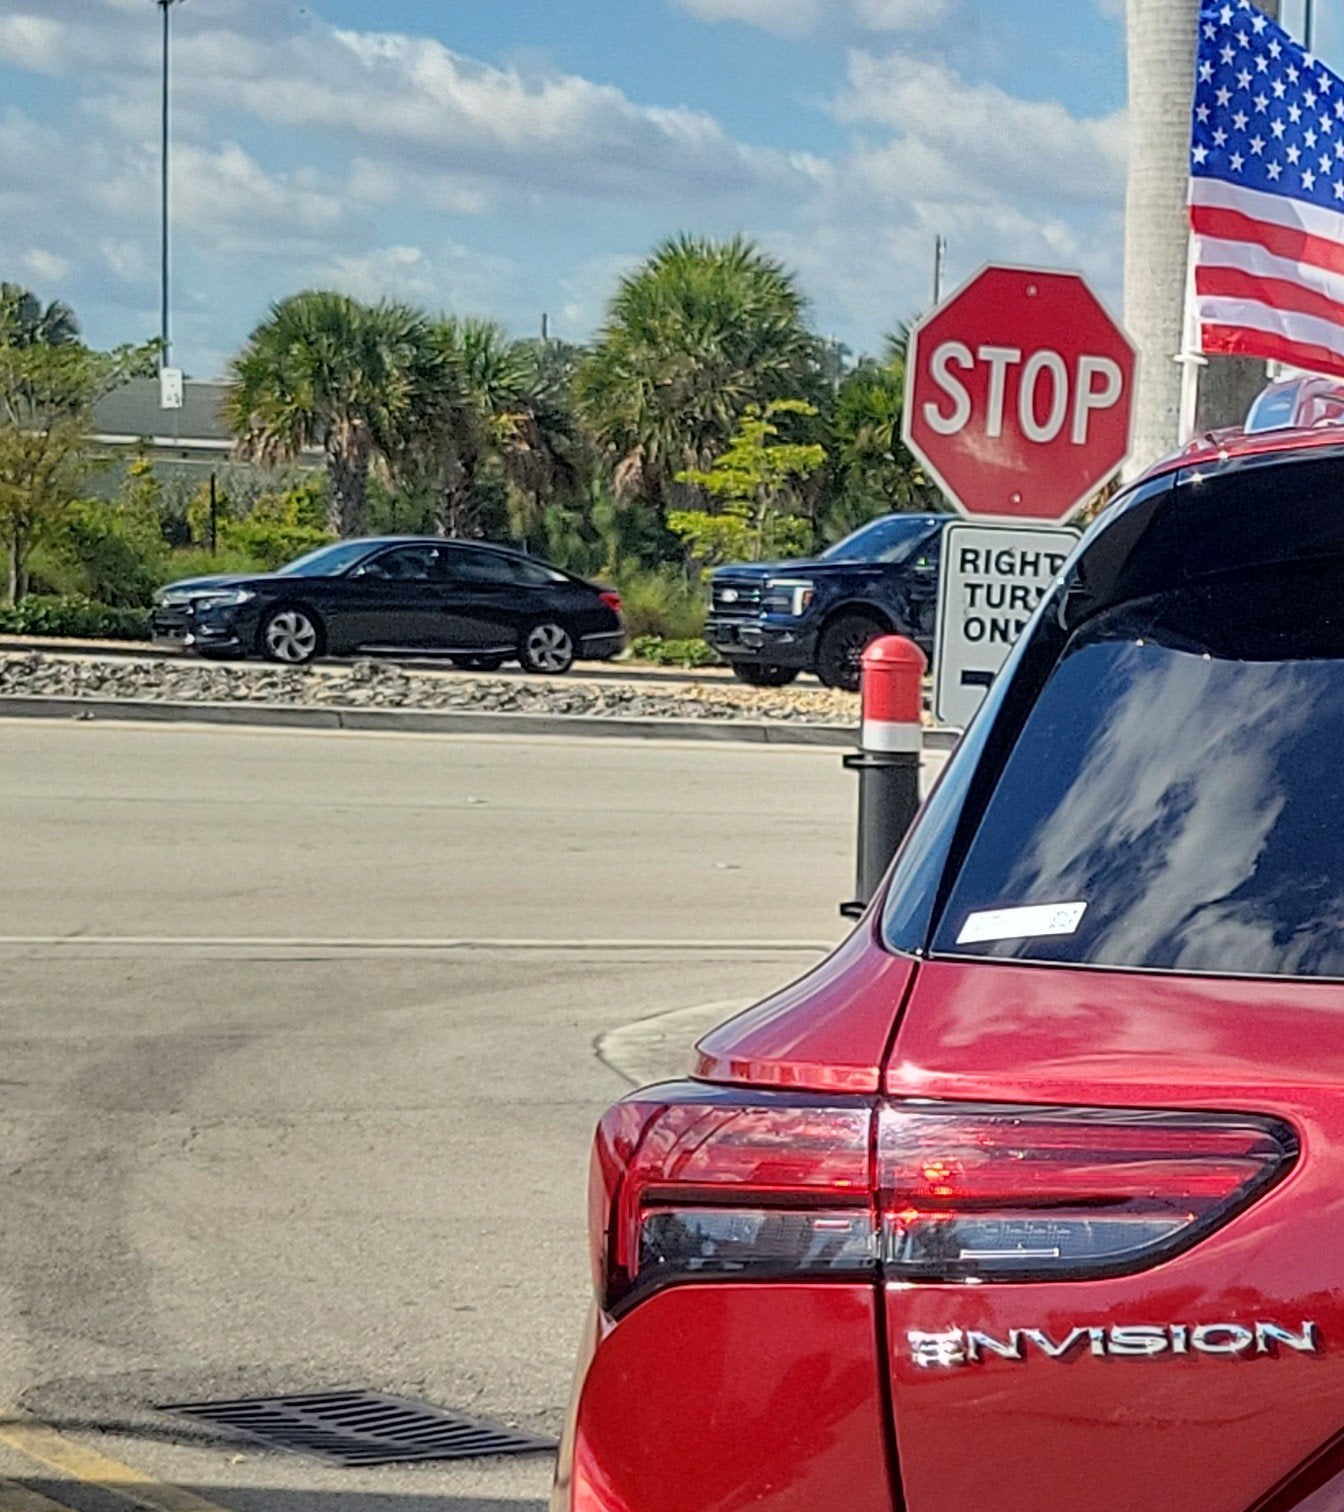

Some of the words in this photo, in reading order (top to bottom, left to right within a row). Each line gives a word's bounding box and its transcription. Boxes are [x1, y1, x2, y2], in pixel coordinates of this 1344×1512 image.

[923, 341, 1123, 445] STOP
[959, 547, 1068, 578] RIGHT
[907, 1320, 1316, 1366] ENVISION
